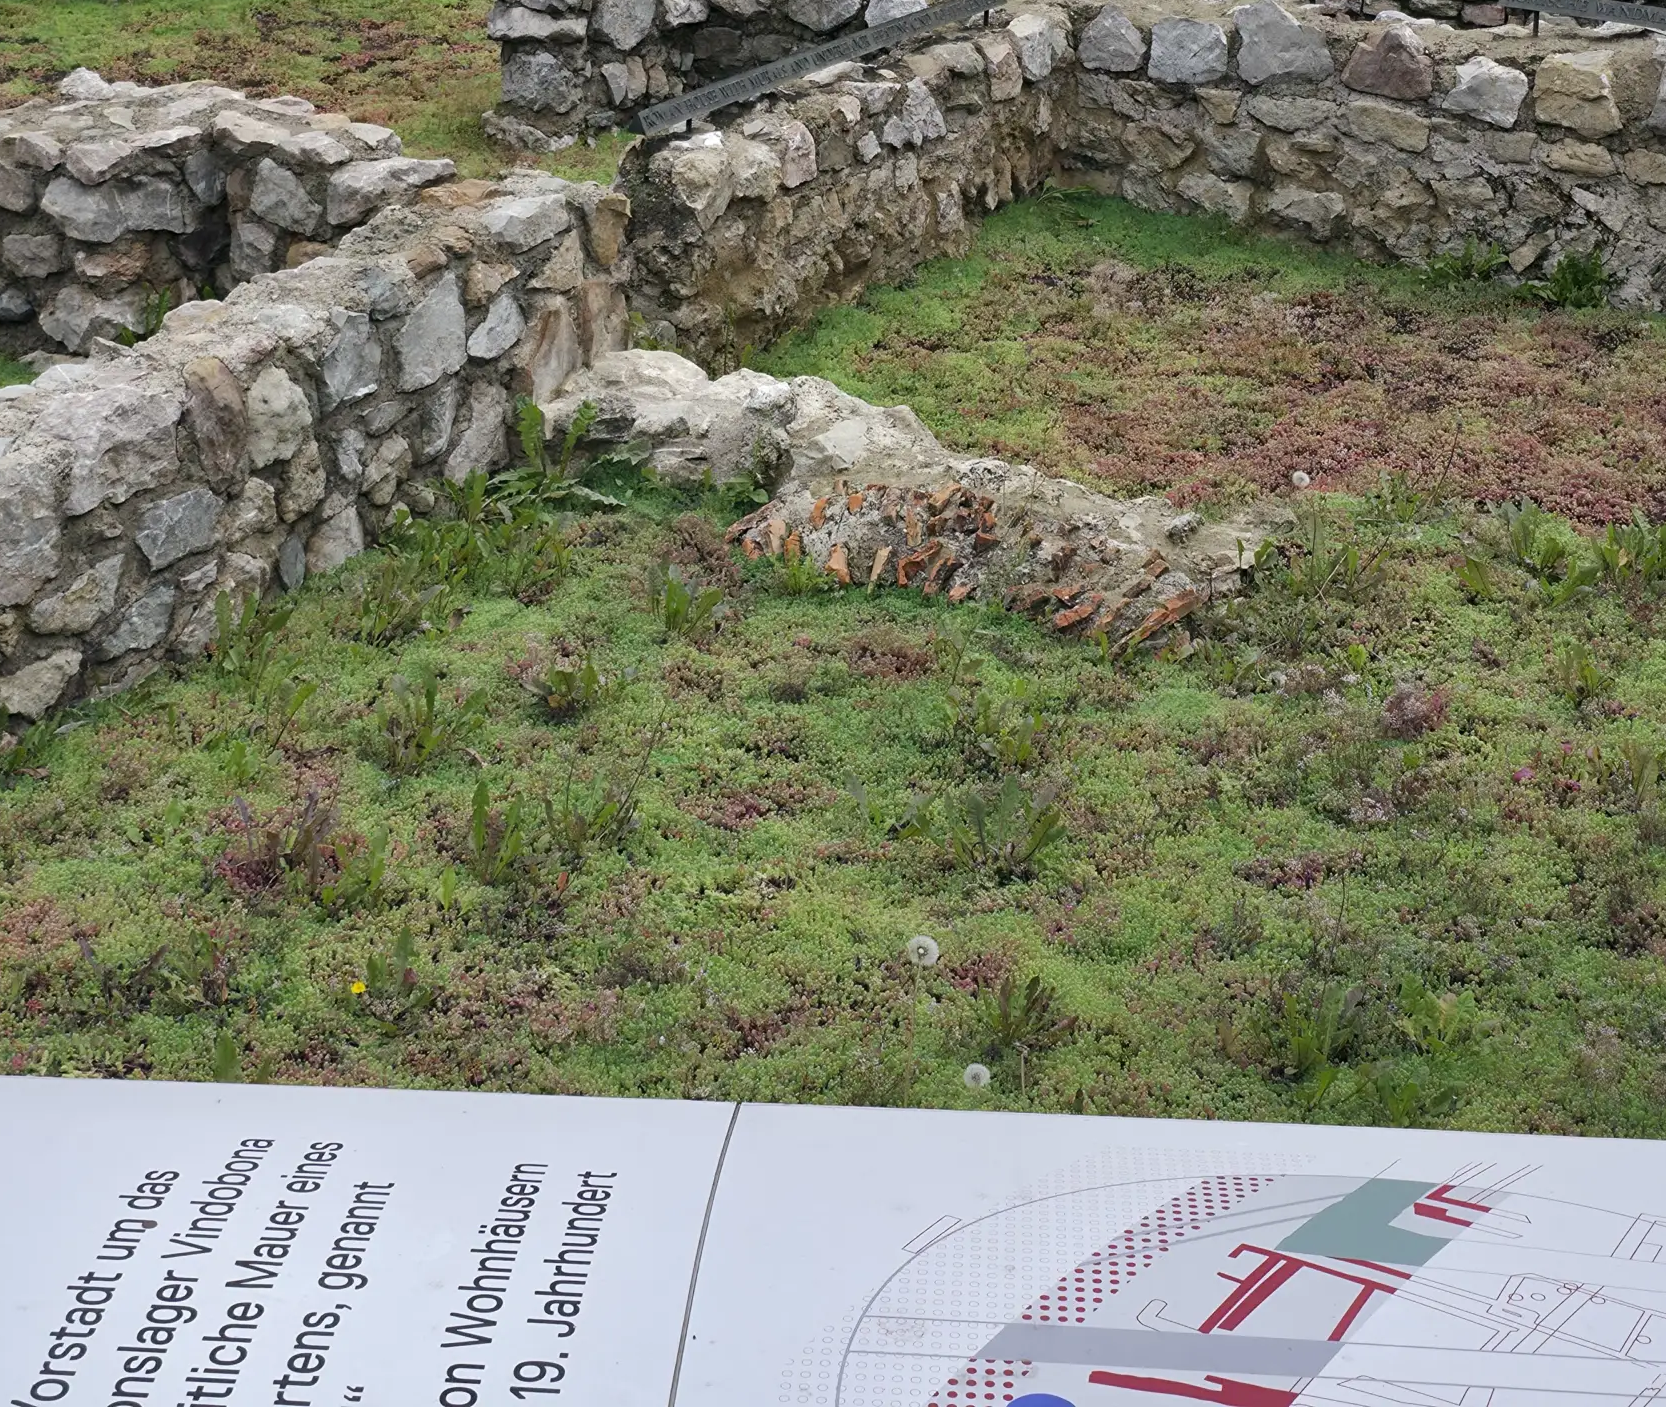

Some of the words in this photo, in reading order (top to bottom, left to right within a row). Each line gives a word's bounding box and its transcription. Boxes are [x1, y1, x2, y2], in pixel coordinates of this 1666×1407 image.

[96, 1218, 145, 1261] um
[118, 1169, 181, 1210] das
[161, 1138, 276, 1259] Vindobona
[224, 1200, 310, 1289] Mauer
[280, 1141, 344, 1193] eines
[318, 1180, 395, 1290] genannt
[440, 1163, 548, 1348] Wohnhäusern
[526, 1170, 618, 1337] Jahrhundert
[10, 1271, 123, 1407] orstadt
[509, 1352, 569, 1400] 19.
